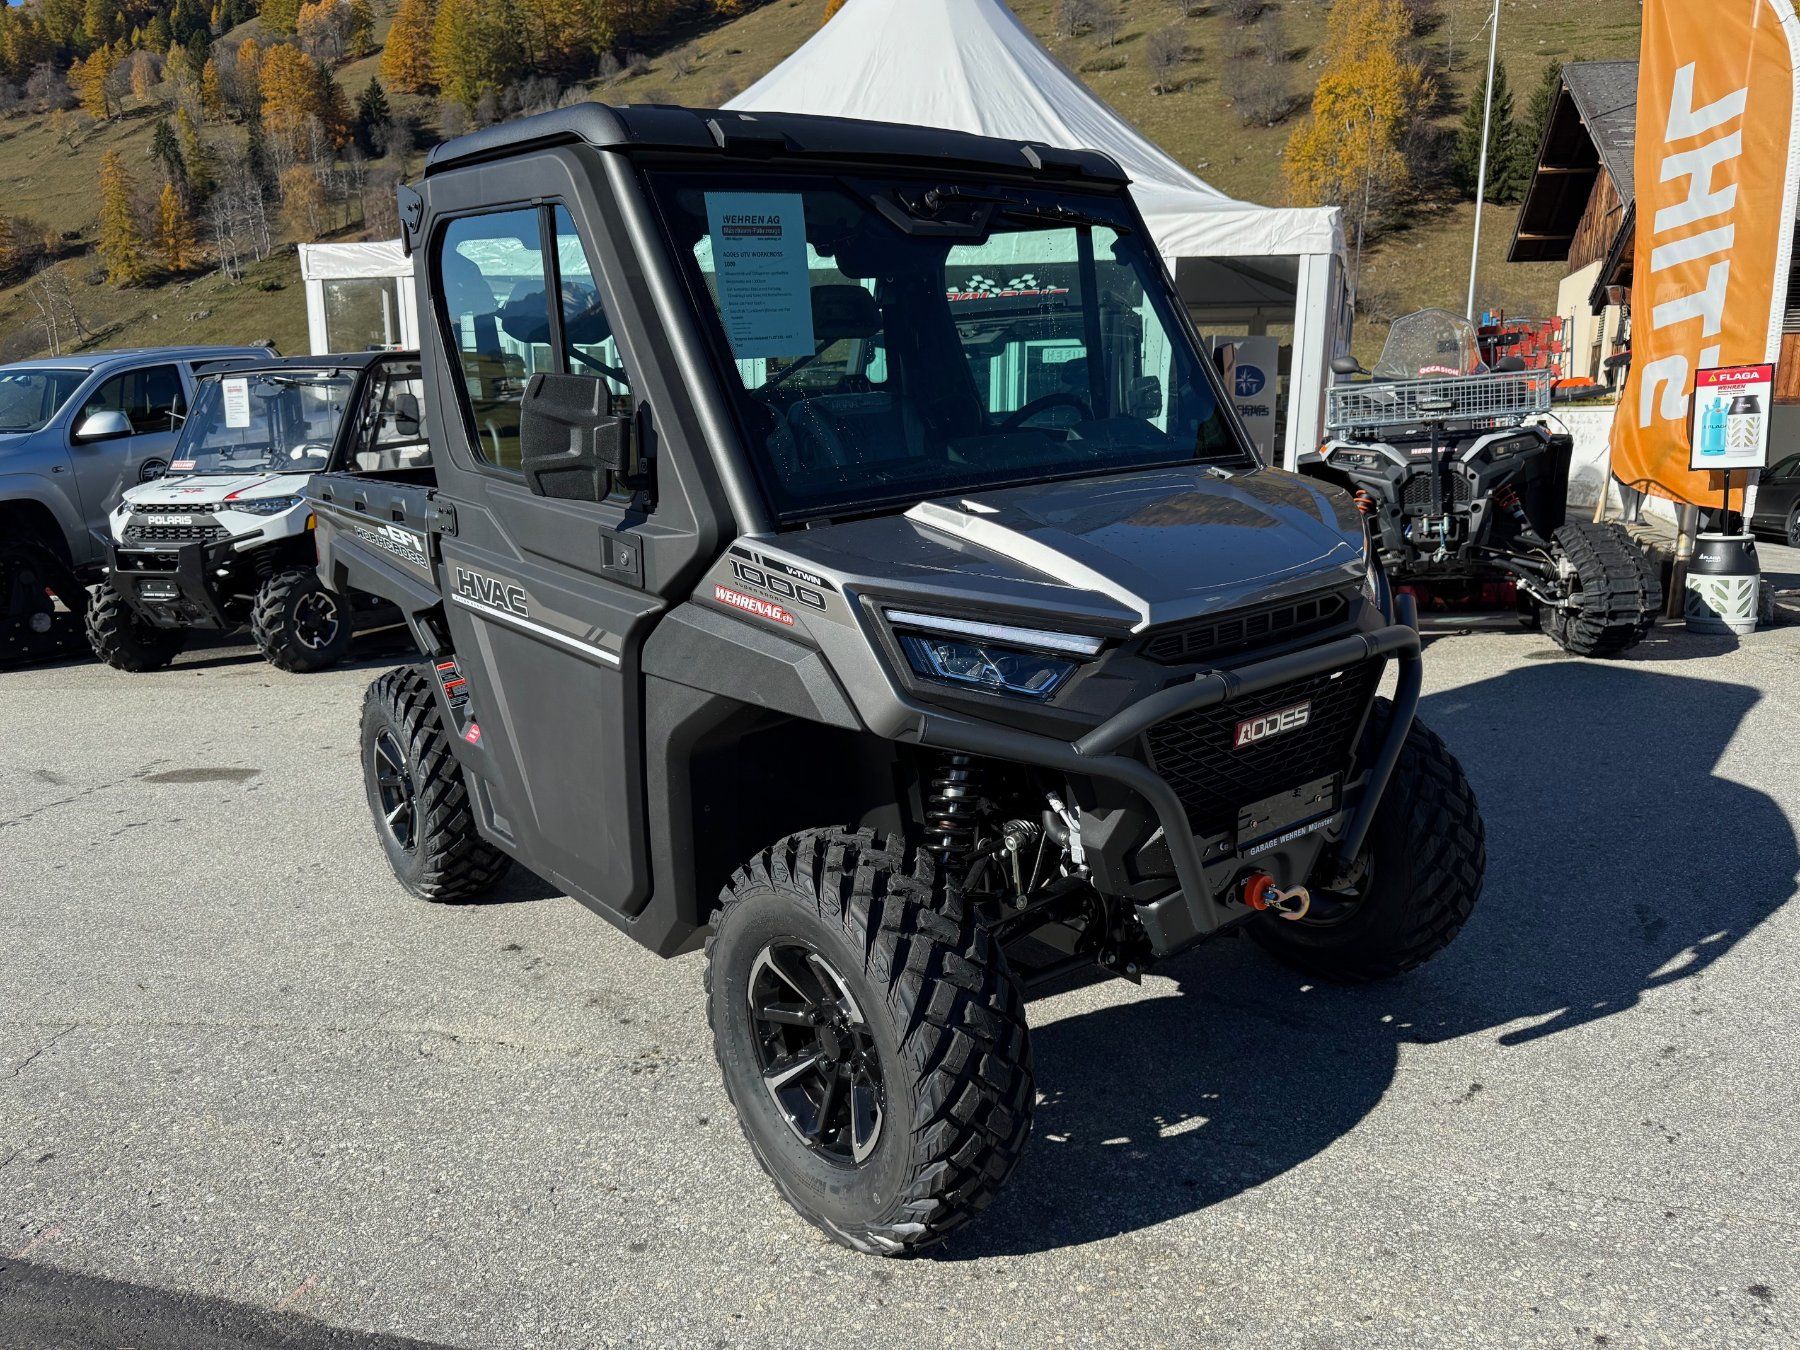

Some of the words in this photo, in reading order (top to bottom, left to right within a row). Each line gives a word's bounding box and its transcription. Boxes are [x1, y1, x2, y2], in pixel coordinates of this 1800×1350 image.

[722, 214, 765, 224] WEHREN
[767, 214, 780, 224] AG
[1419, 366, 1459, 376] OCCASION
[1719, 372, 1760, 382] FLAGA
[147, 515, 193, 525] POLARIS
[385, 524, 423, 553] EFI
[456, 566, 529, 618] HVAC
[729, 558, 829, 613] 1000
[714, 586, 793, 625] WEHRENAG.ch
[1237, 701, 1309, 746] AODES
[1250, 838, 1278, 856] GARAGE
[1279, 827, 1306, 844] WEHREN
[1308, 817, 1333, 832] Münster
